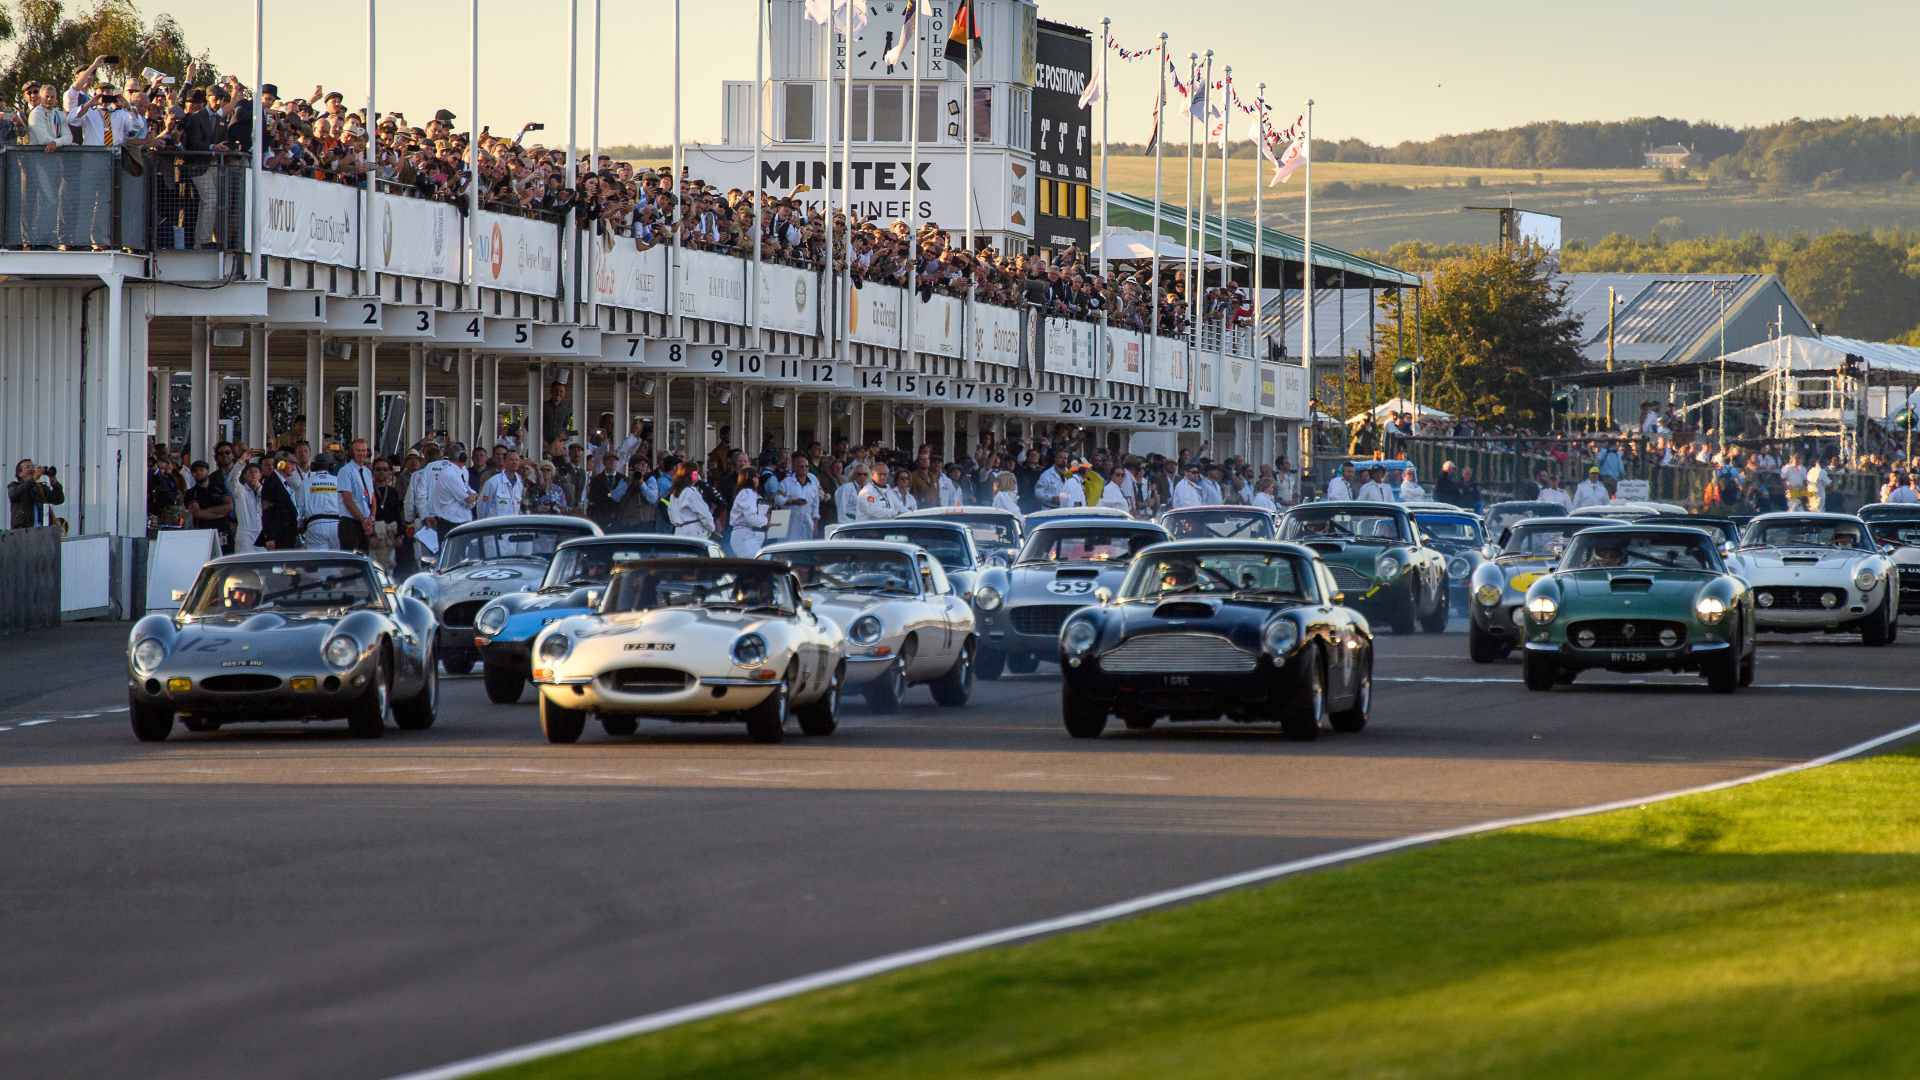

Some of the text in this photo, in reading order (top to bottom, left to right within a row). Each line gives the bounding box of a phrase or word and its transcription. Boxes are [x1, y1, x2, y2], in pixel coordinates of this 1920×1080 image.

[932, 8, 943, 70] ROLEX
[1036, 62, 1085, 95] CE POSITIONS
[761, 161, 931, 191] MINTEX
[268, 197, 295, 233] MOTUL
[315, 296, 320, 317] 1
[362, 304, 377, 324] 2
[417, 311, 429, 331] 3
[466, 318, 480, 337] 4
[514, 324, 528, 343] 5
[561, 330, 575, 348] 6
[627, 339, 640, 357] 7
[669, 344, 682, 362] 8
[711, 350, 723, 368] 9
[739, 355, 760, 373] 10
[780, 360, 798, 377] 11
[812, 365, 833, 382] 12
[862, 371, 882, 388] 14
[896, 375, 916, 392] 15
[926, 380, 946, 397] 16
[956, 383, 975, 399] 17
[985, 387, 1005, 403] 18
[1014, 392, 1034, 407] 19
[1061, 398, 1083, 414] 20
[1090, 402, 1108, 417] 21
[1111, 405, 1132, 420] 22
[1137, 408, 1156, 423] 23
[1158, 411, 1178, 427] 24
[1181, 413, 1201, 429] 25
[1054, 581, 1092, 593] 59
[180, 637, 232, 652] 12
